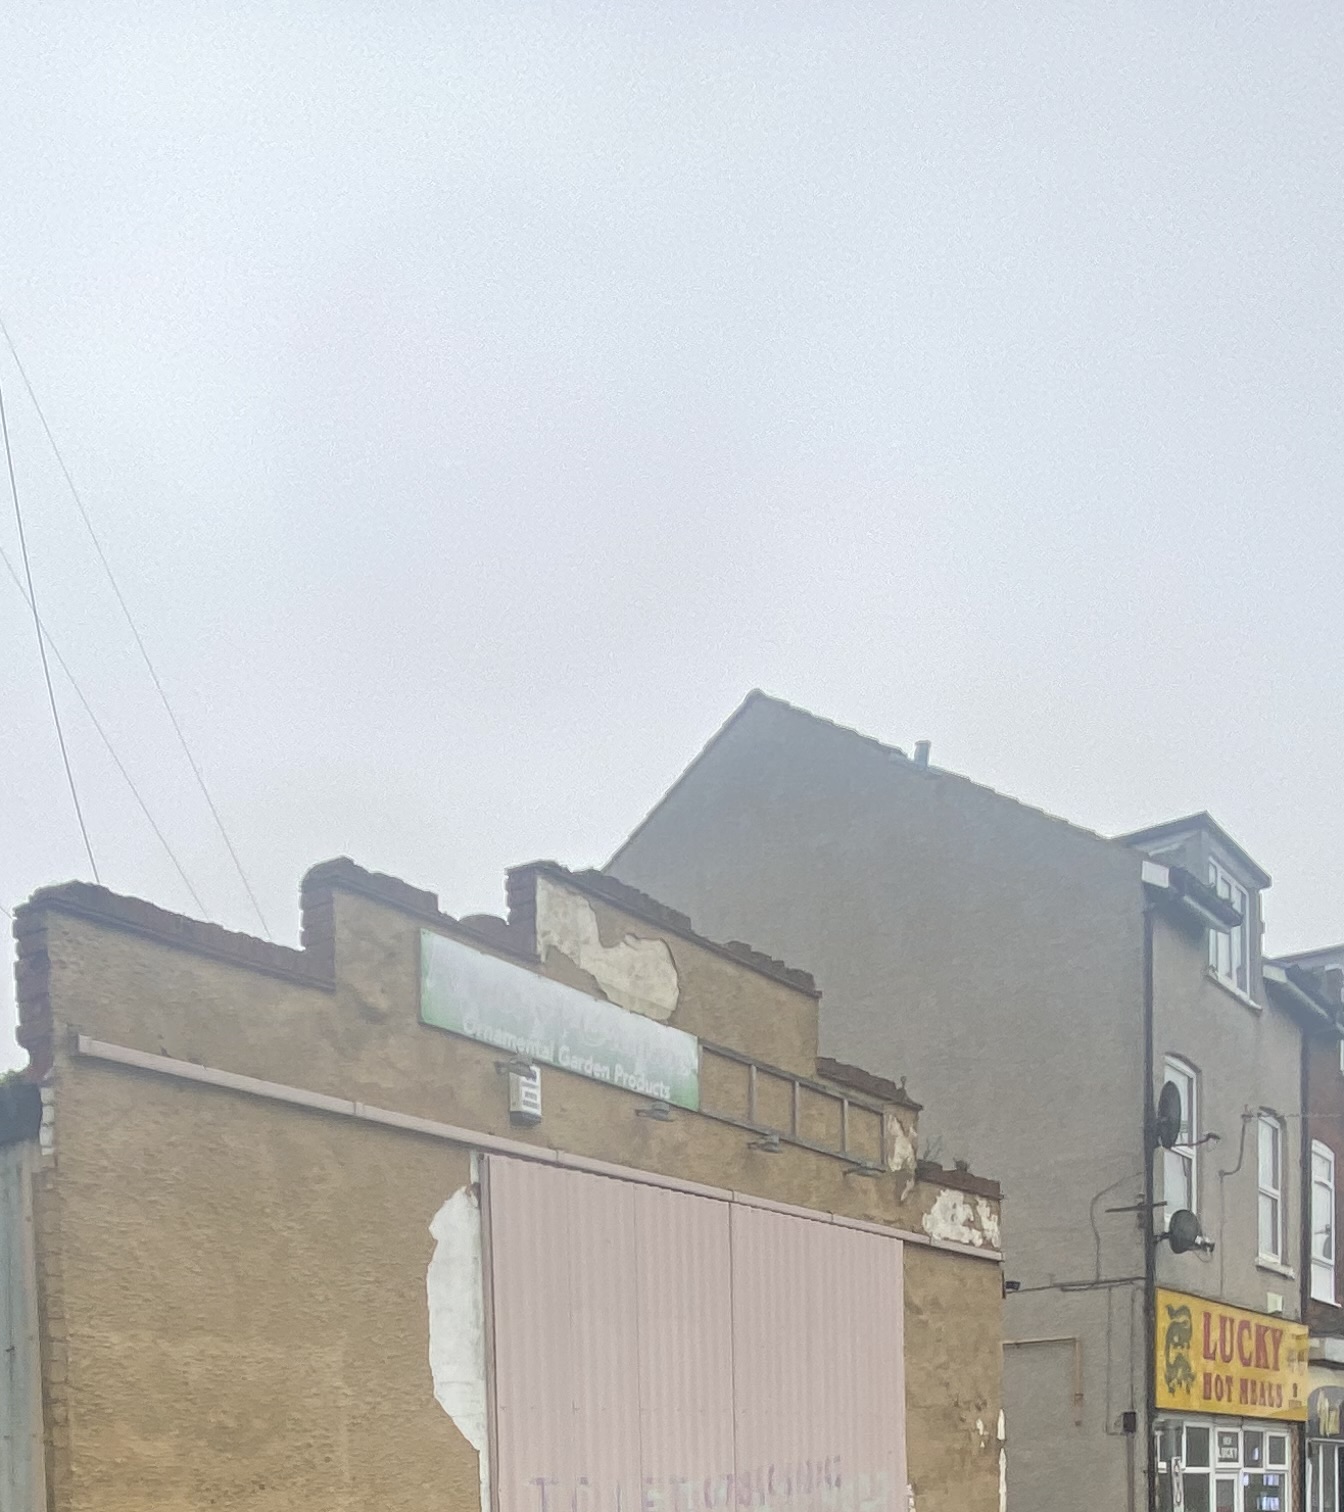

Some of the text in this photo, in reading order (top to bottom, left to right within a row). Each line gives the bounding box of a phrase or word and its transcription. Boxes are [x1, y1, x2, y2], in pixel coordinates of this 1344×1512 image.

[463, 1021, 671, 1100] Ornamental Garden Products
[1202, 1311, 1284, 1372] LUCKY
[1202, 1372, 1284, 1409] HOT MEALS
